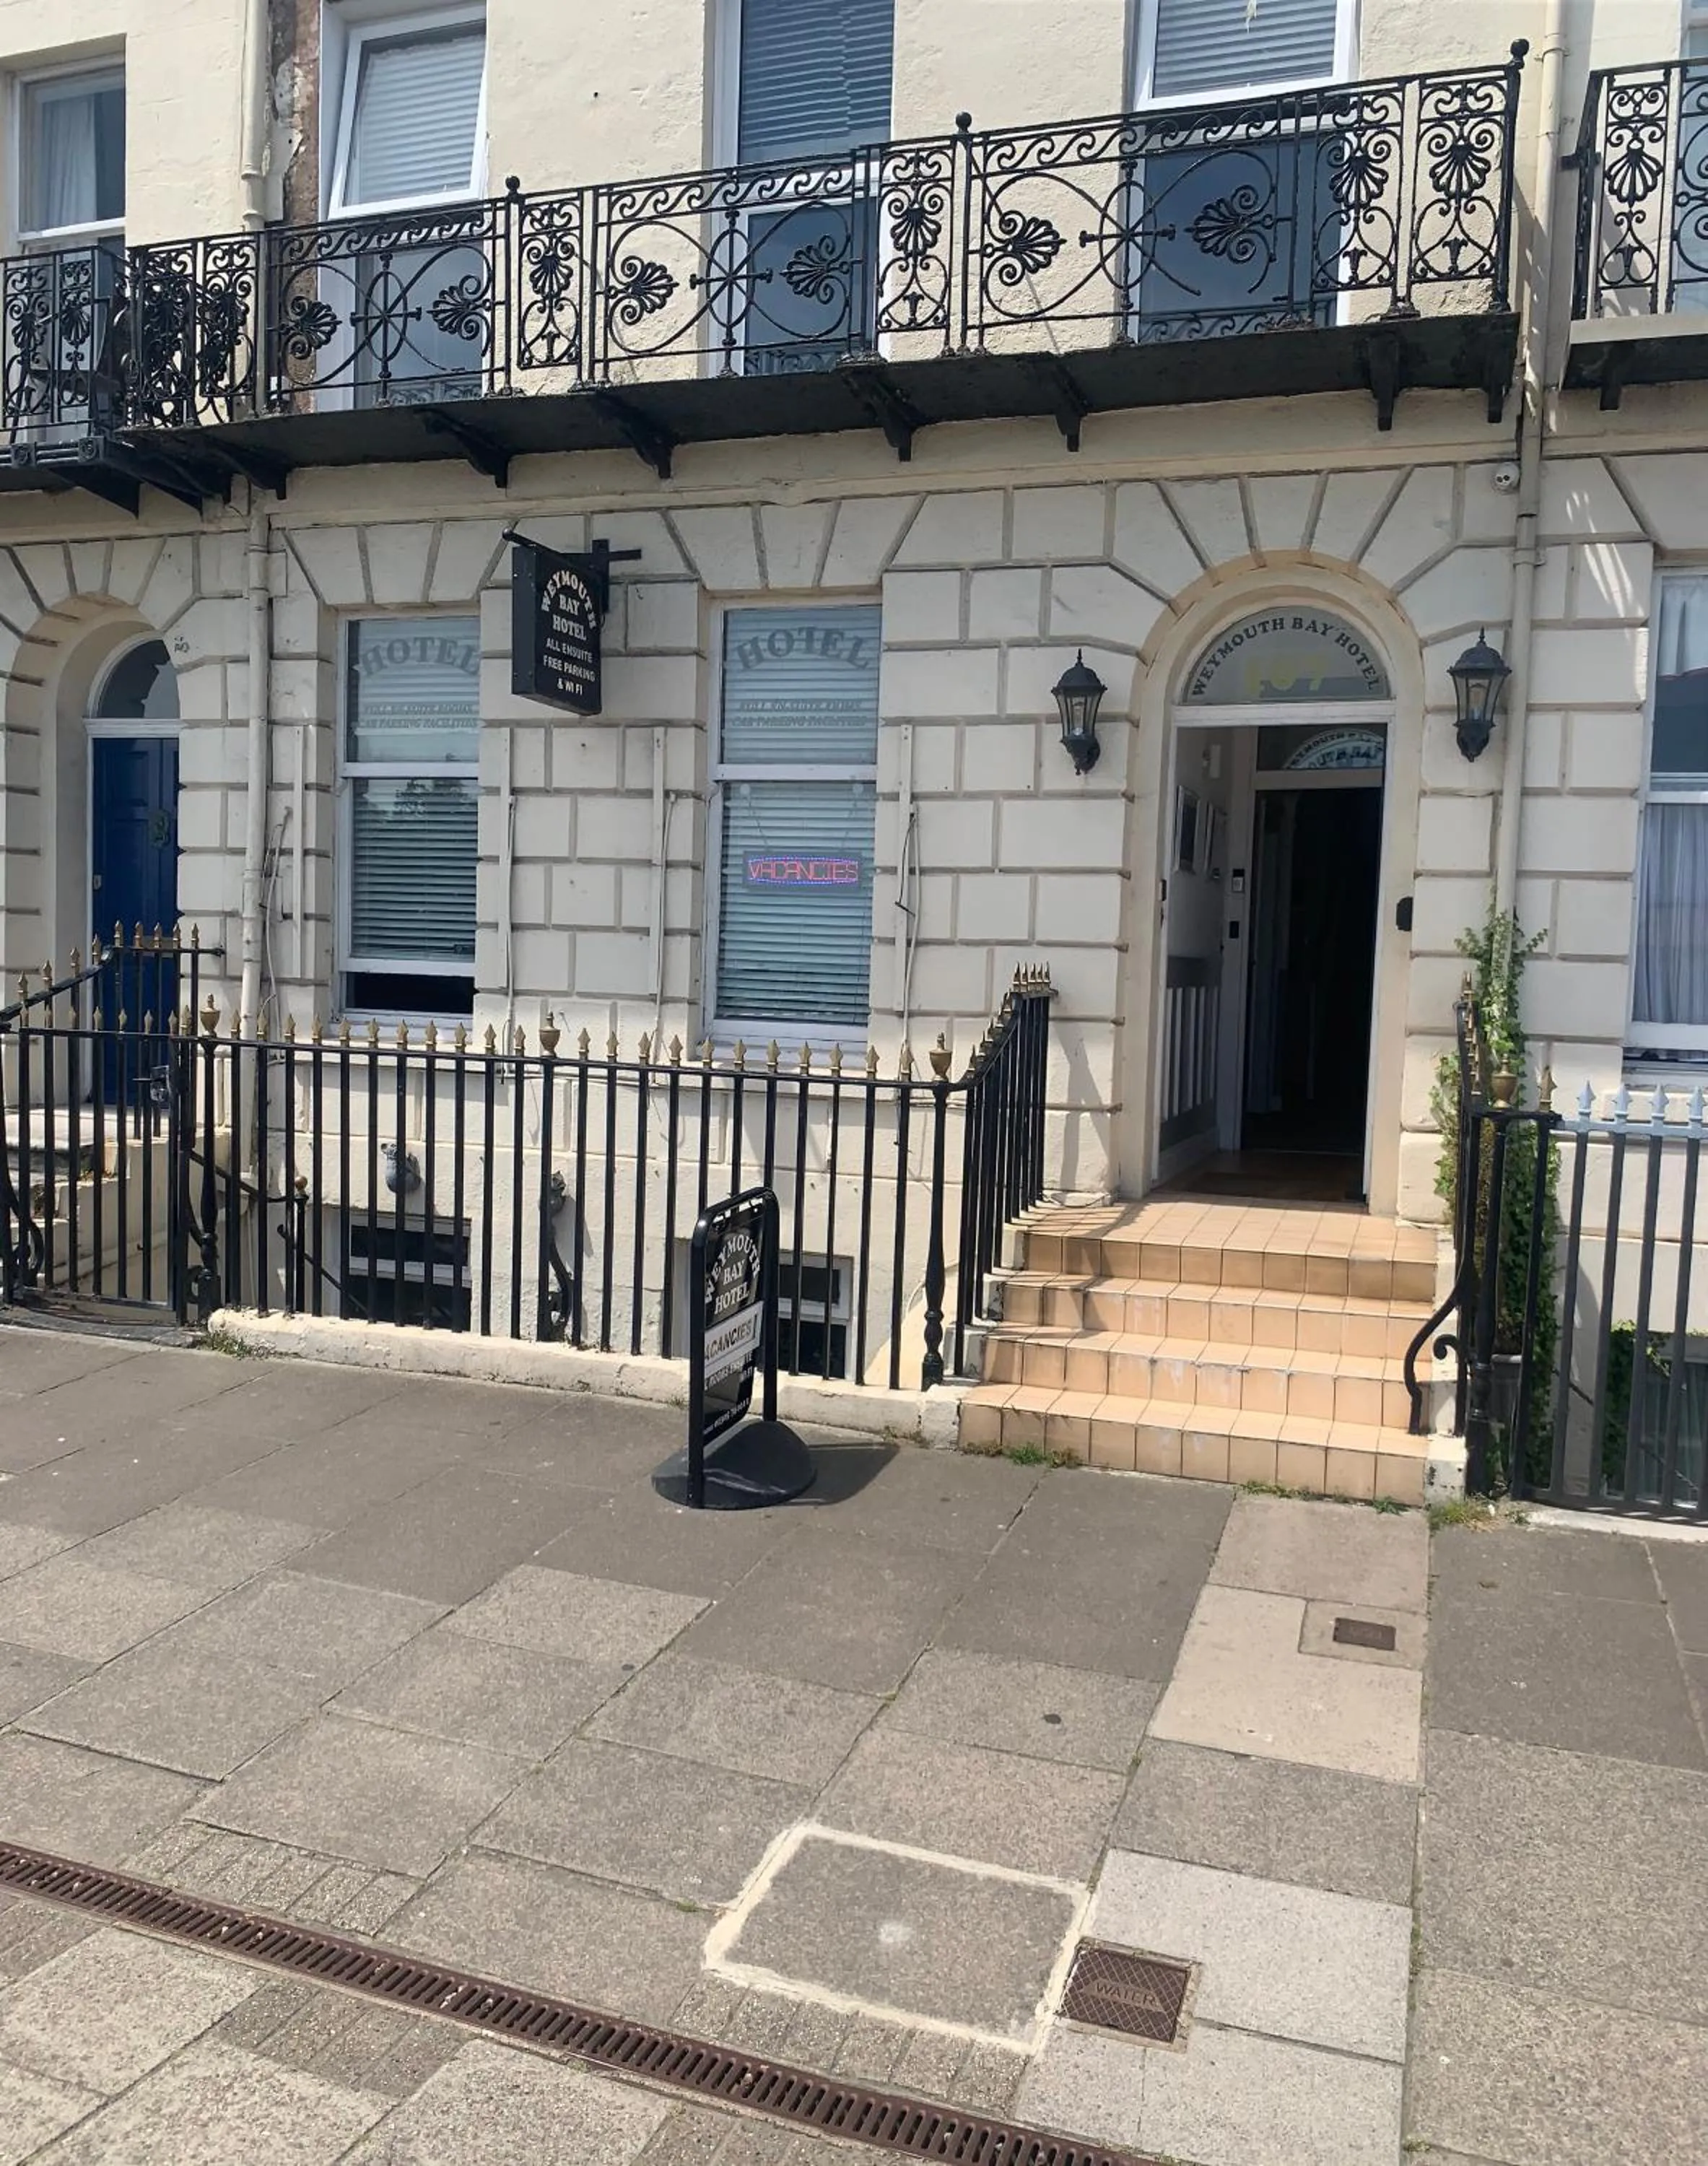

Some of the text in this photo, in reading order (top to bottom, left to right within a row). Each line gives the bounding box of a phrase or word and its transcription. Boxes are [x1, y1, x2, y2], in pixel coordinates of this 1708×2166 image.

[541, 570, 596, 629] WEYMOUTH
[559, 593, 580, 615] BAY
[553, 614, 586, 640] HOTEL
[361, 636, 480, 676] HOTEL
[546, 638, 593, 664] ALL ENSUITE
[735, 626, 869, 670] HOTEL
[1191, 617, 1380, 696] WEYMOUTH BAY HOTEL
[543, 655, 596, 682] FREE PARKING
[557, 678, 564, 690] &
[749, 860, 858, 880] VACANCIES
[705, 1233, 760, 1303] WEYMOUTH
[723, 1258, 746, 1286] BAY
[714, 1282, 749, 1314] HOTEL
[1095, 1983, 1156, 2006] WATER
